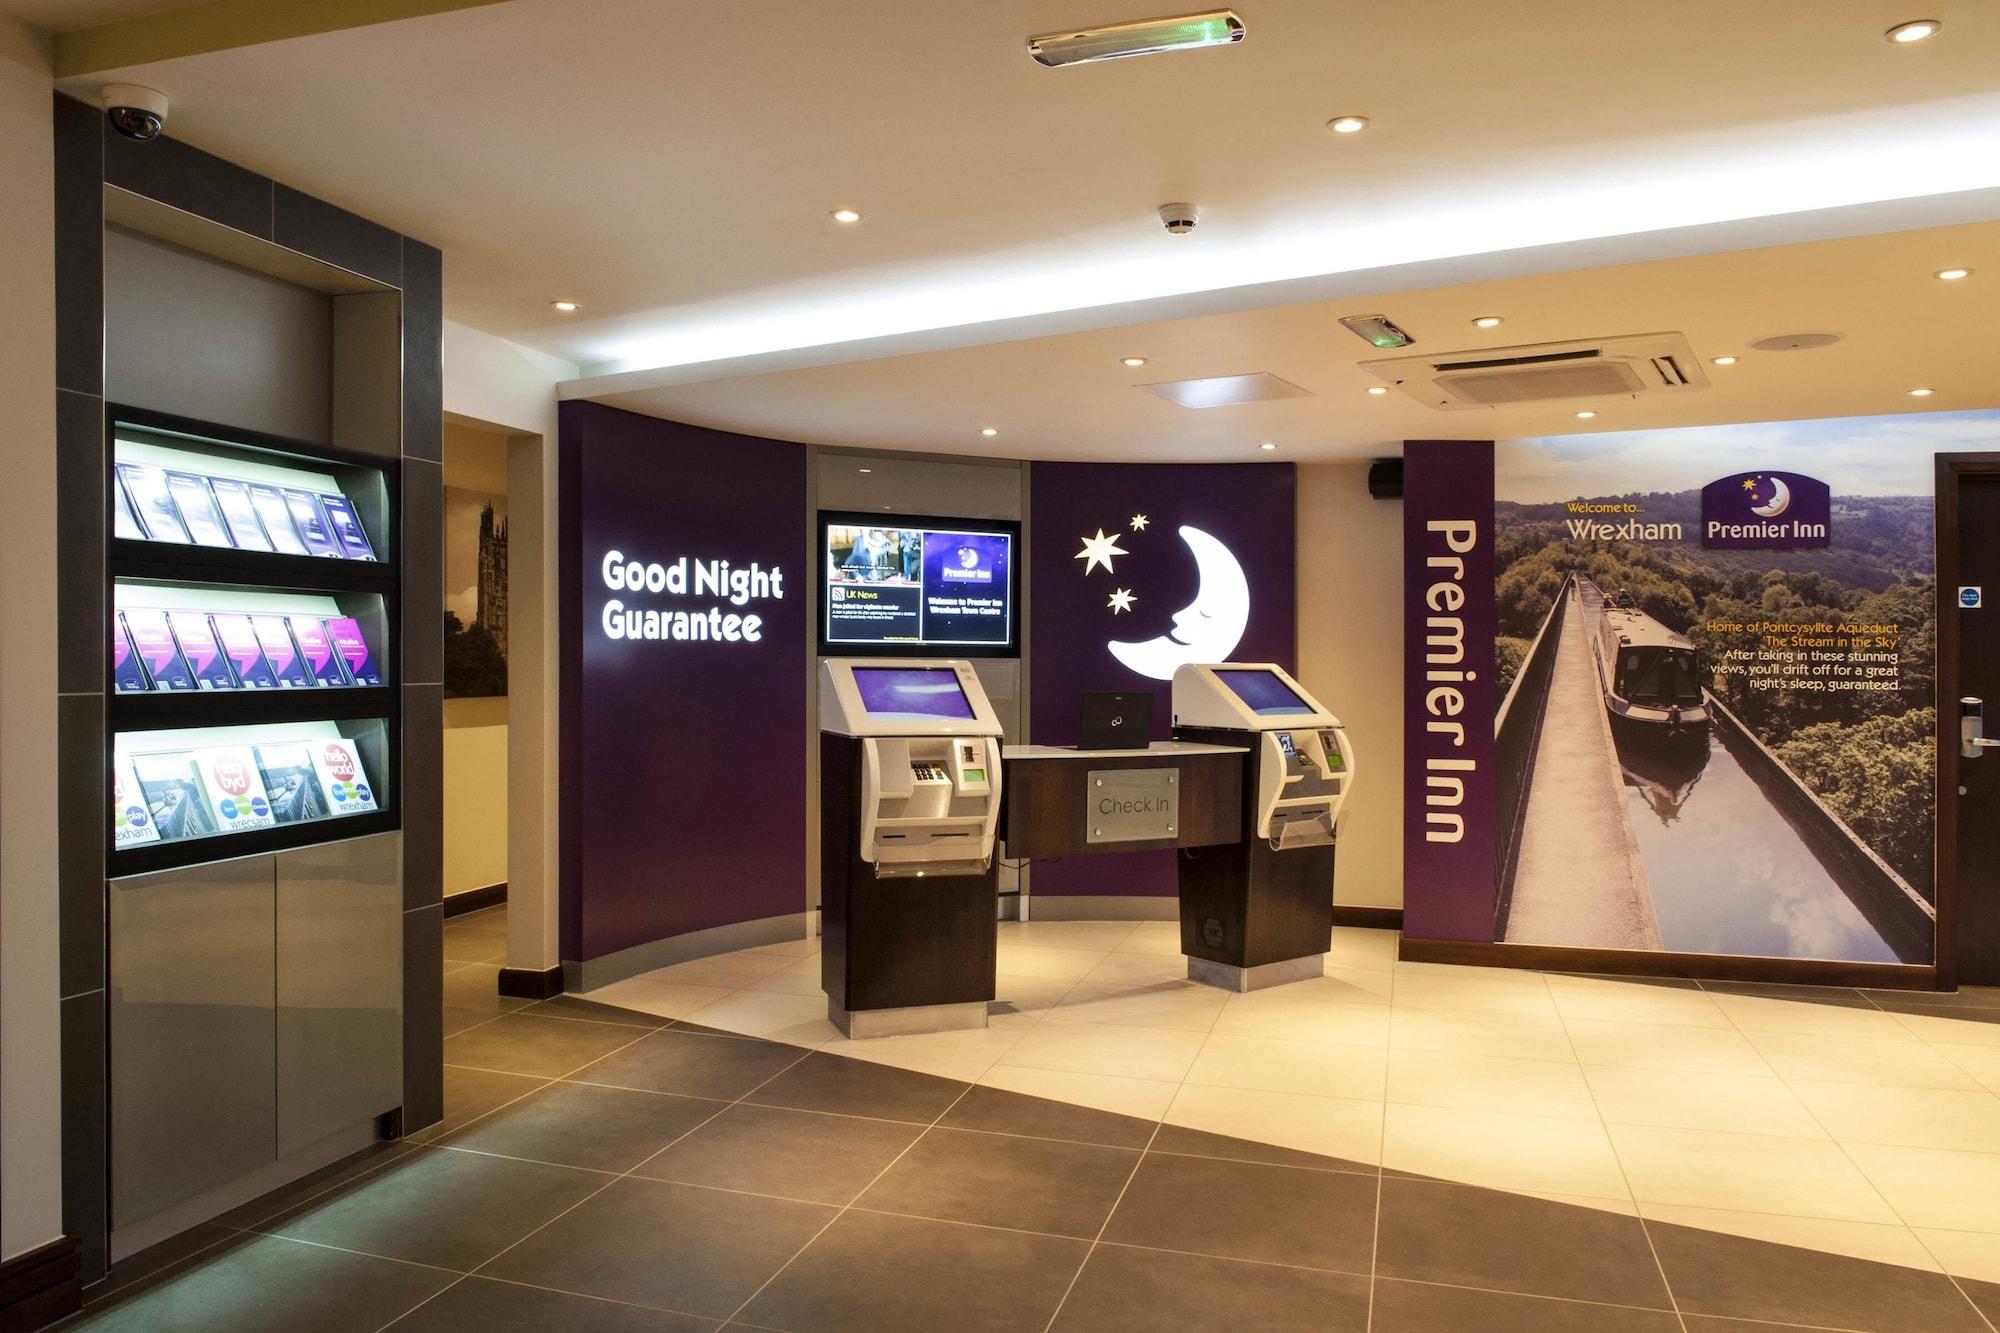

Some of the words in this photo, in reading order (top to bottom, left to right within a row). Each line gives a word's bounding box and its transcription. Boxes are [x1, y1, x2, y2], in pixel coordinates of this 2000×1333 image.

[1567, 502, 1621, 513] Welcome
[1622, 503, 1645, 513] to...
[1566, 518, 1681, 541] Wrexham
[1708, 520, 1789, 539] Premier
[1793, 520, 1825, 538] Inn
[602, 549, 687, 595] Good
[694, 557, 784, 606] Night
[943, 567, 976, 578] Premier
[977, 569, 990, 579] Inn
[846, 590, 857, 599] UK
[857, 591, 878, 600] News
[928, 597, 958, 606] Welcome
[602, 599, 763, 643] Guarantee
[1706, 622, 1742, 634] Home
[1746, 622, 1760, 634] of
[1836, 623, 1899, 635] Aqueduct
[1425, 519, 1477, 747] Premier
[1791, 636, 1834, 648] Stream
[1837, 637, 1848, 648] in
[1851, 637, 1872, 648] the
[1723, 650, 1755, 661] After
[1758, 650, 1794, 662] taking
[1797, 650, 1807, 661] in
[1811, 651, 1845, 662] these
[1848, 651, 1899, 665] stunning
[1710, 664, 1748, 676] views,
[1749, 664, 1780, 678] you'll
[1783, 664, 1810, 676] drift
[1812, 664, 1831, 676] off
[1833, 665, 1851, 677] for
[1855, 668, 1863, 677] a
[1866, 667, 1899, 679] great
[1749, 678, 1788, 692] night's
[1790, 679, 1826, 692] sleep,
[1828, 679, 1902, 693] guaranteed.
[339, 801, 374, 811] wrexham
[1099, 796, 1152, 815] Check
[1156, 796, 1169, 812] In
[1425, 759, 1476, 843] Inn
[127, 811, 147, 824] play
[229, 817, 271, 830] wrecsam
